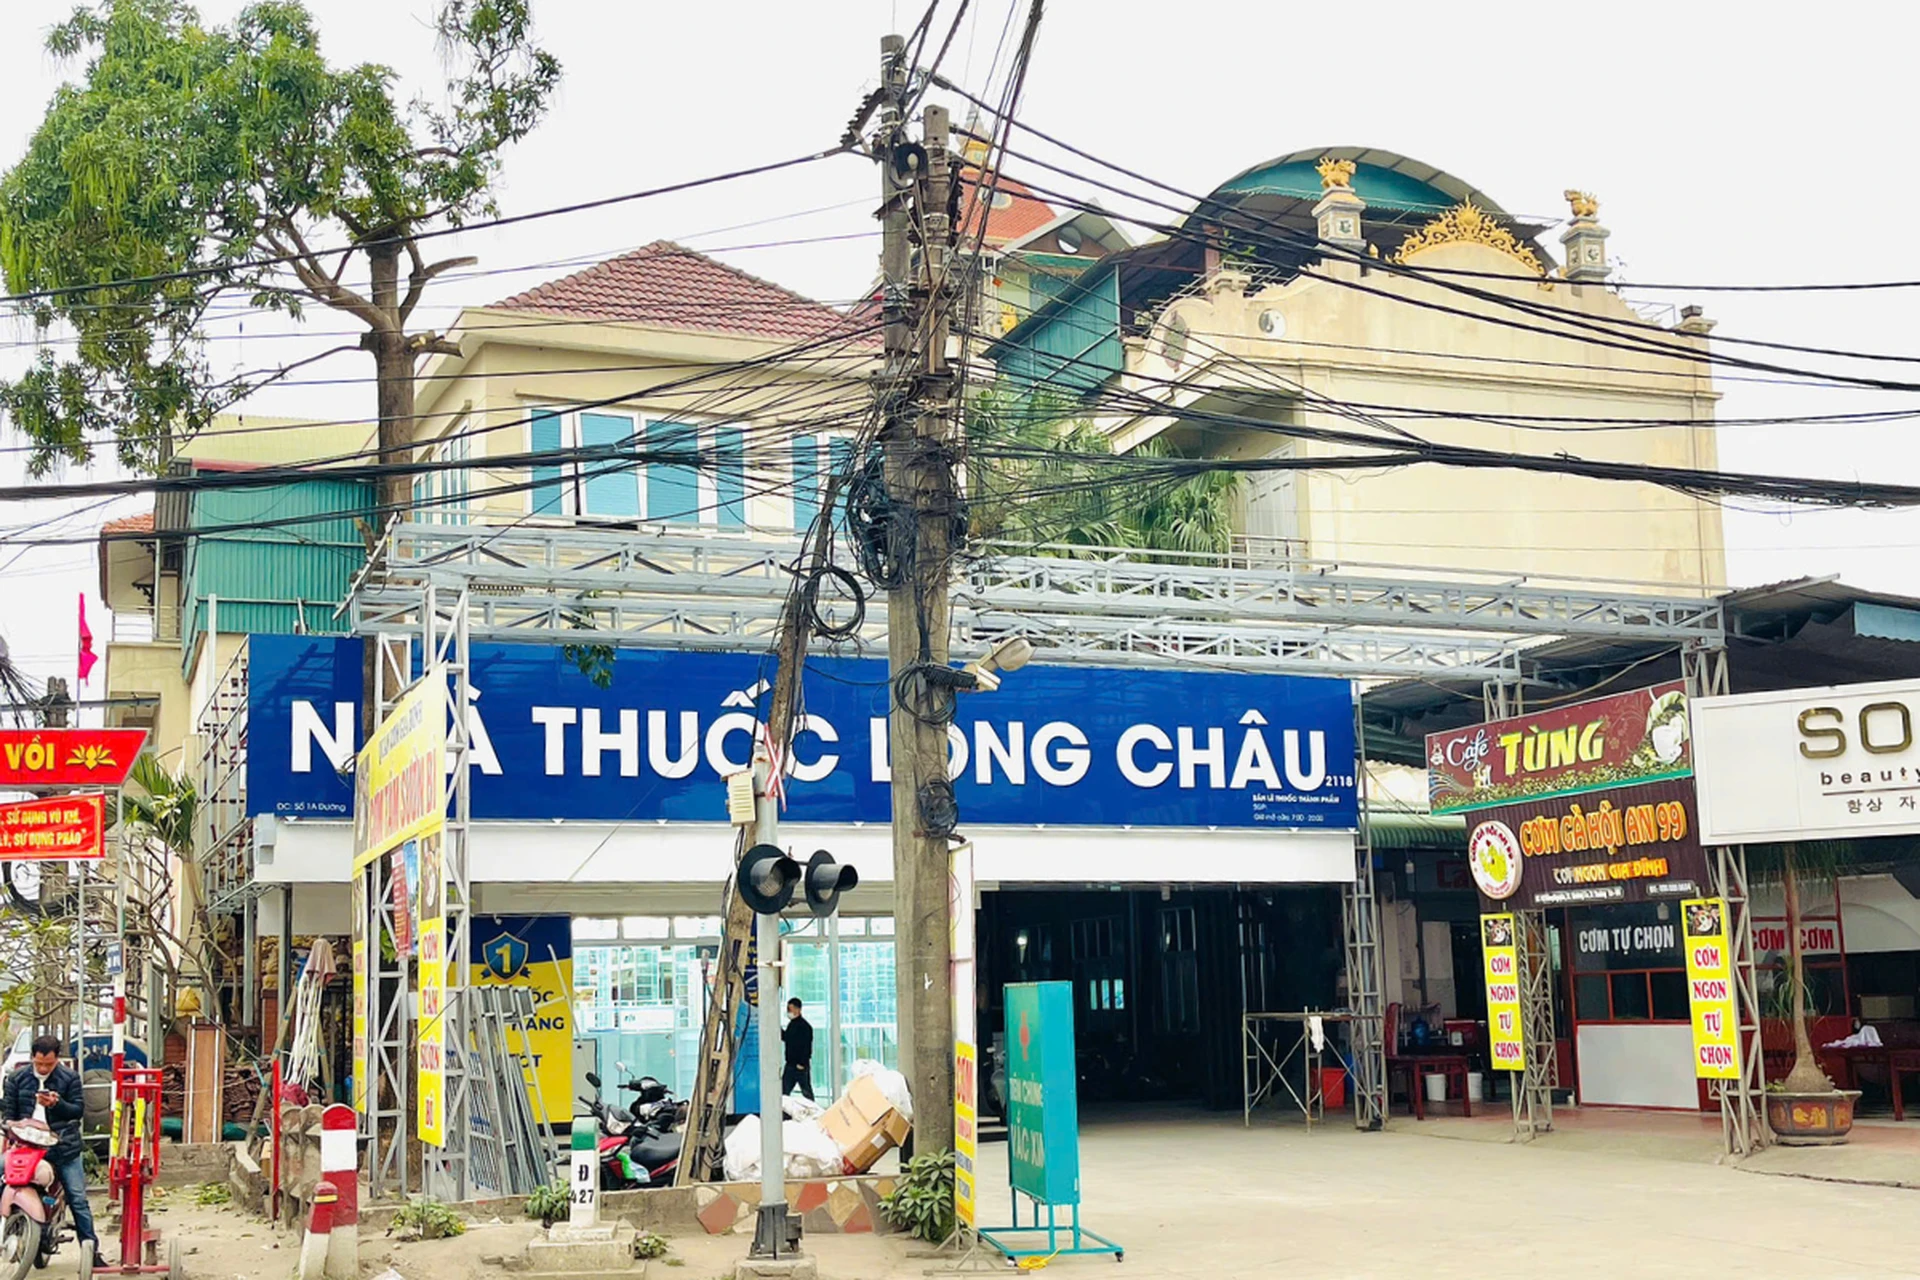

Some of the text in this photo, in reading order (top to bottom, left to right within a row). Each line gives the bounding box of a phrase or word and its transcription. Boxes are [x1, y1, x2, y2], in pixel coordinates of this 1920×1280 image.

[532, 679, 839, 782] THUỐC
[1116, 709, 1326, 792] CHÂU
[1500, 720, 1604, 776] TÙNG
[1325, 775, 1354, 788] 2118
[1520, 816, 1561, 857] CƠM
[1560, 804, 1590, 852] GÀ
[1624, 804, 1659, 845] AN
[1655, 801, 1687, 842] 99
[1579, 924, 1674, 955] CƠM TỰ CHỌN
[495, 943, 512, 973] 1
[1695, 945, 1720, 967] CƠM
[1490, 985, 1517, 1001] NGON
[1693, 981, 1727, 999] NGON
[1704, 1011, 1721, 1037] TỰ
[1700, 1046, 1732, 1070] CHỌN
[578, 1164, 589, 1182] Đ
